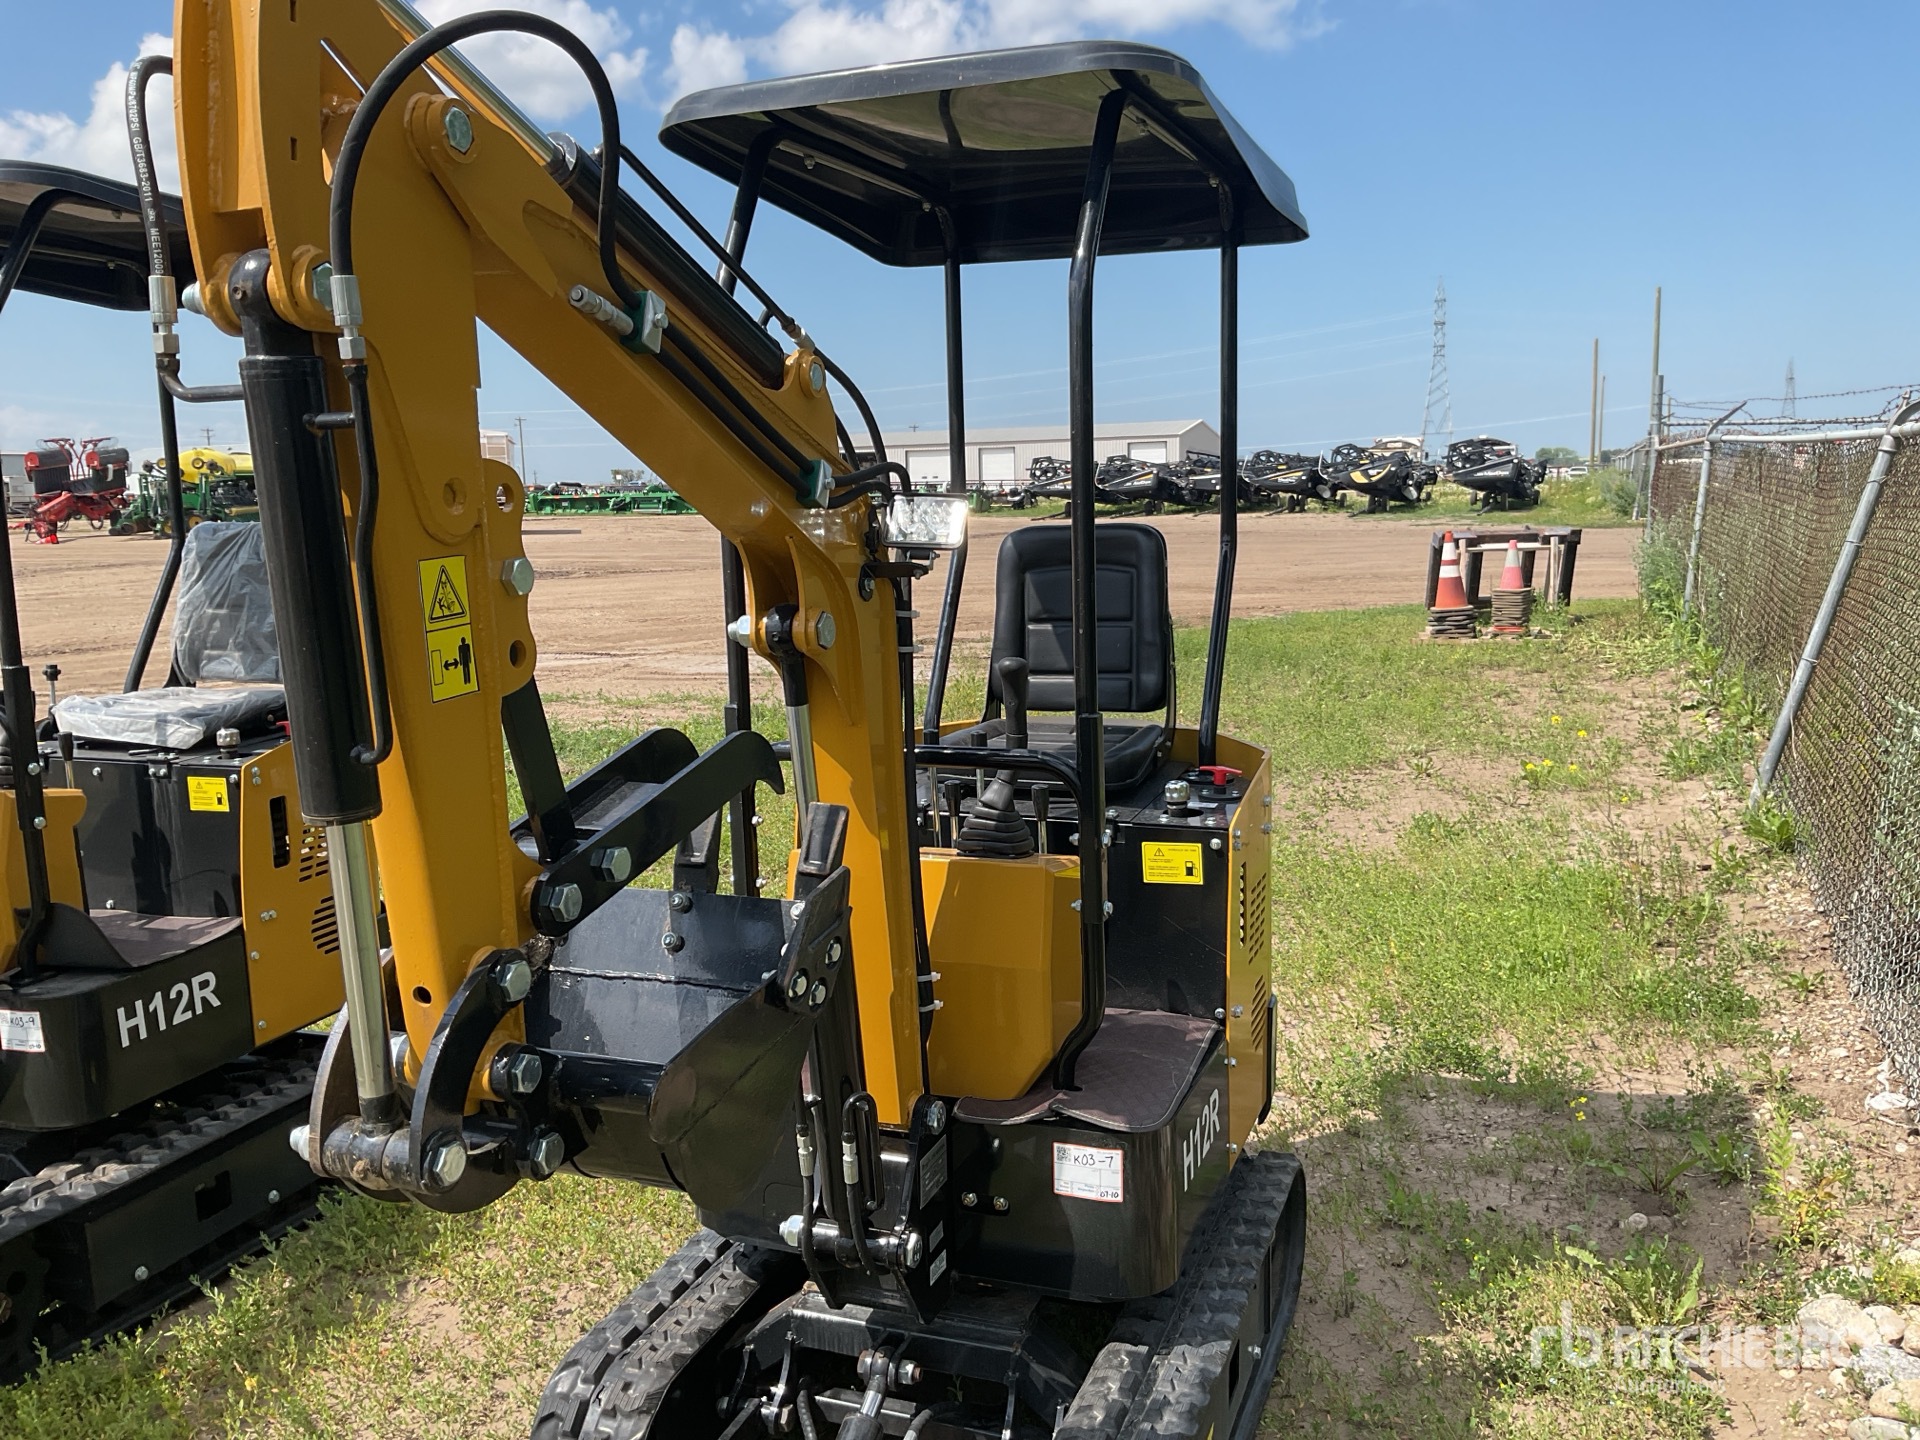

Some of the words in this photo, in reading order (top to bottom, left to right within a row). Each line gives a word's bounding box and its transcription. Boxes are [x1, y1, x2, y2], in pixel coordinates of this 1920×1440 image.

[133, 136, 153, 202] GB/T3683-2011
[150, 228, 163, 275] MEE12009
[116, 971, 221, 1048] H12R
[1073, 1153, 1114, 1168] K03-7
[1183, 1088, 1221, 1192] H12R
